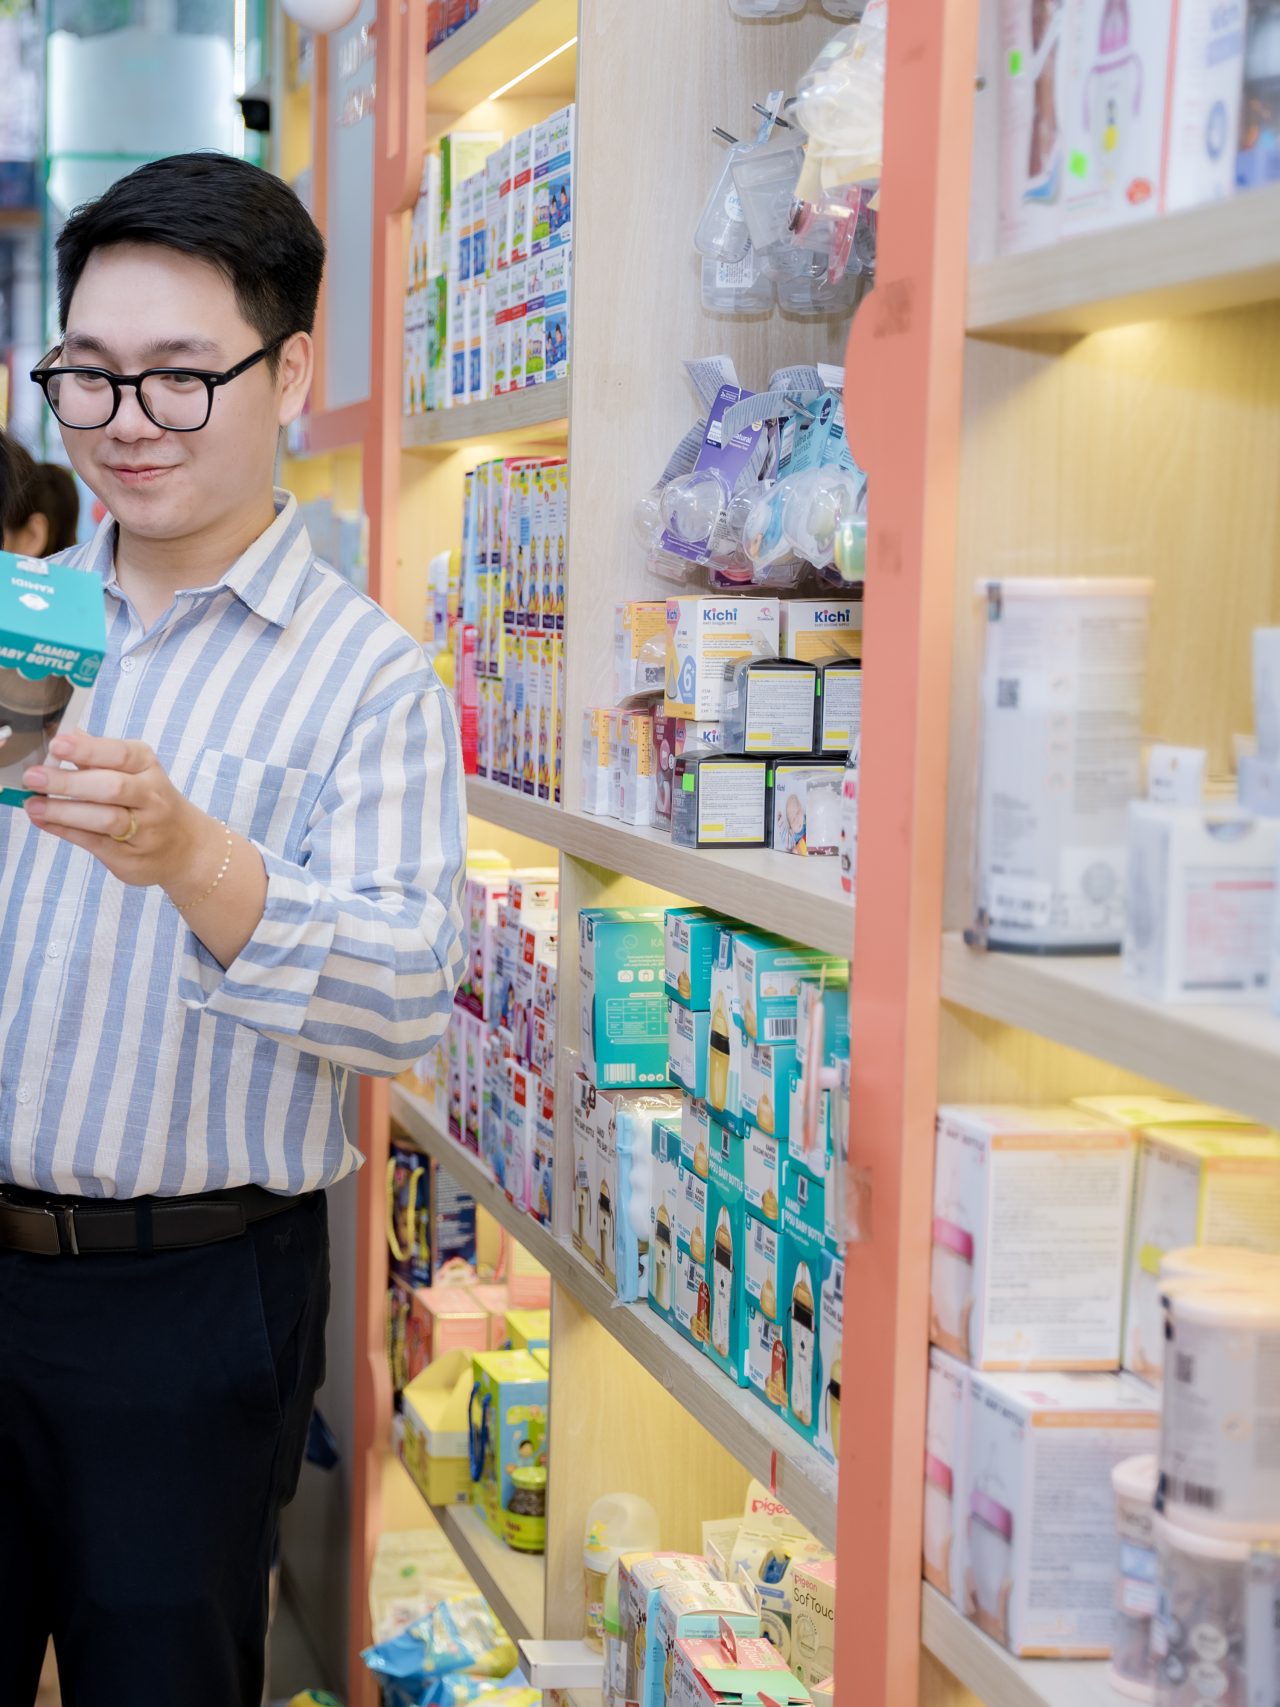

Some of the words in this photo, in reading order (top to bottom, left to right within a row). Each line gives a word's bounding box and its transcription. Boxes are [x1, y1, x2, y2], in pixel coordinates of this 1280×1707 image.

[732, 432, 753, 444] atural
[703, 607, 738, 621] Kichi
[814, 609, 850, 623] Kichi
[33, 643, 81, 660] KAMIDI
[25, 653, 75, 671] BOTTLE
[751, 1498, 792, 1516] pige
[794, 1573, 818, 1593] pigeon
[793, 1587, 835, 1621] SofTouc
